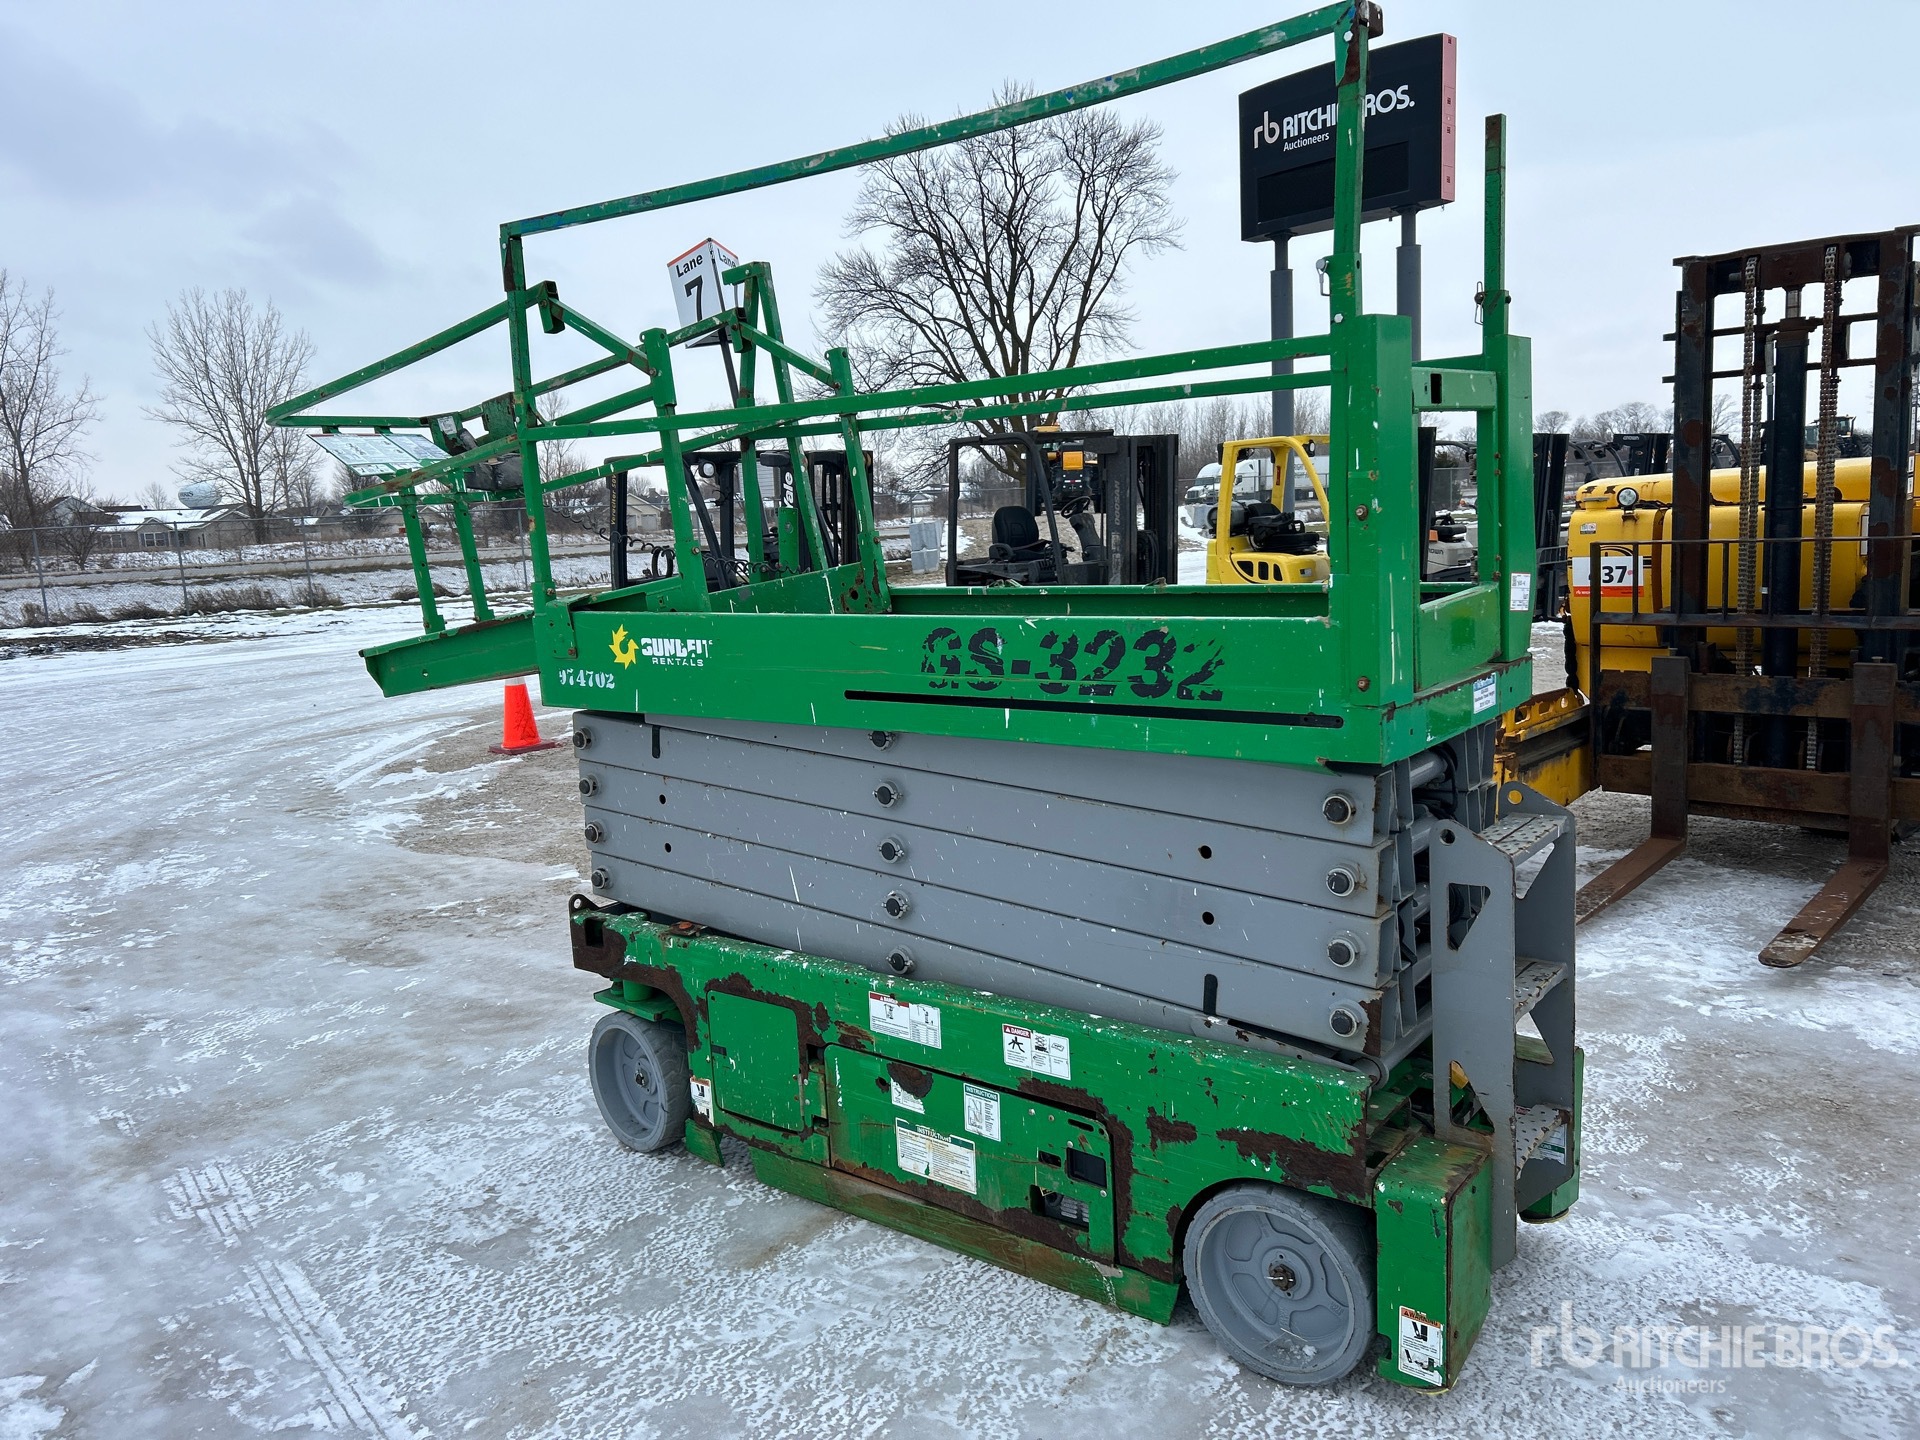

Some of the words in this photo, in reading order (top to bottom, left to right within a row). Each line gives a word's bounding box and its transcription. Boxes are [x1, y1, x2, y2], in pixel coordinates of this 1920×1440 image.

[1283, 102, 1339, 140] RITCHI
[1363, 85, 1416, 118] ROS.
[1283, 132, 1330, 152] Auctioneers
[676, 254, 704, 278] Lane
[684, 275, 703, 322] 7
[783, 471, 794, 509] Yale
[651, 657, 705, 668] RENTALS
[558, 667, 616, 690] 974702
[1010, 1026, 1030, 1038] DANGER
[965, 1087, 998, 1101] INSTRUCTIONS
